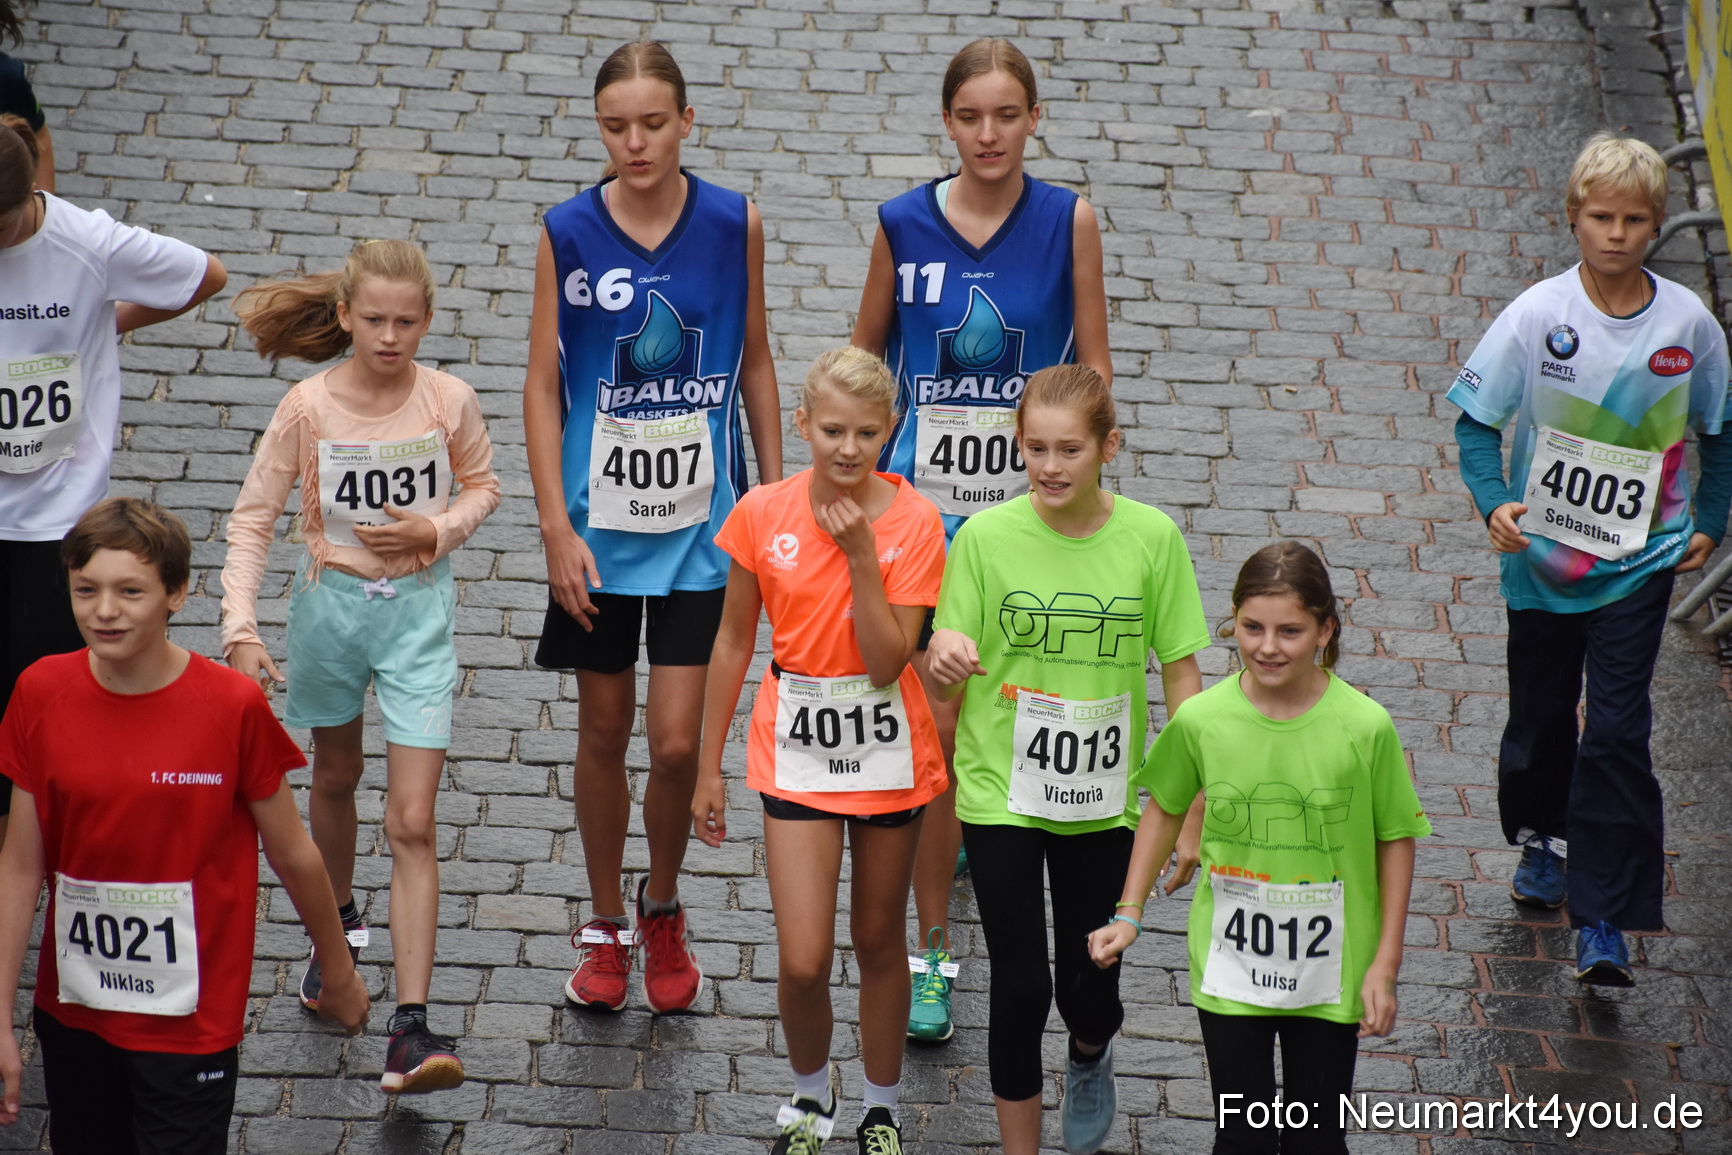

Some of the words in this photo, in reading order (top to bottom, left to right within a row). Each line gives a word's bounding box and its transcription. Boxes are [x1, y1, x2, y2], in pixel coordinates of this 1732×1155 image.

[564, 267, 635, 312] 66
[897, 262, 947, 304] 11
[1541, 361, 1577, 377] PARTL
[1654, 355, 1689, 369] Hervis
[1458, 367, 1483, 390] CK
[1540, 370, 1576, 384] Neumarkt
[600, 377, 728, 412] IBALON
[0, 380, 72, 430] 026
[643, 417, 701, 439] BOCK
[928, 417, 969, 427] NeuerMarkt
[601, 427, 637, 441] NeuerMarkt
[0, 440, 43, 458] Marie
[379, 436, 439, 459] BOCK
[1546, 440, 1584, 458] NeuerMarkt
[602, 442, 702, 490] 4007
[1590, 446, 1652, 470] BOCK
[335, 460, 436, 510] 4031
[952, 486, 1005, 502] Louisa
[1540, 459, 1646, 520] 4003
[629, 500, 676, 517] Sarah
[1545, 508, 1621, 546] Sebastian
[788, 688, 823, 699] NeuerMarkt
[831, 679, 893, 697] BOC
[1027, 707, 1066, 721] NeuerMarkt
[1073, 700, 1125, 720] BOCK
[788, 701, 899, 749] 4015
[1026, 725, 1121, 775] 4013
[828, 759, 861, 774] Mia
[150, 771, 159, 784] 1.
[162, 772, 176, 784] FC
[178, 772, 222, 785] DEINING
[1044, 784, 1104, 805] Victoria
[62, 890, 100, 904] NeuerMarkt
[107, 888, 179, 904] BOCK
[1266, 888, 1334, 904] BOCK
[69, 911, 177, 964] 4021
[1224, 907, 1333, 961] 4012
[100, 971, 155, 994] Niklas
[1252, 968, 1298, 991] Luisa
[208, 1070, 224, 1080] JAKO
